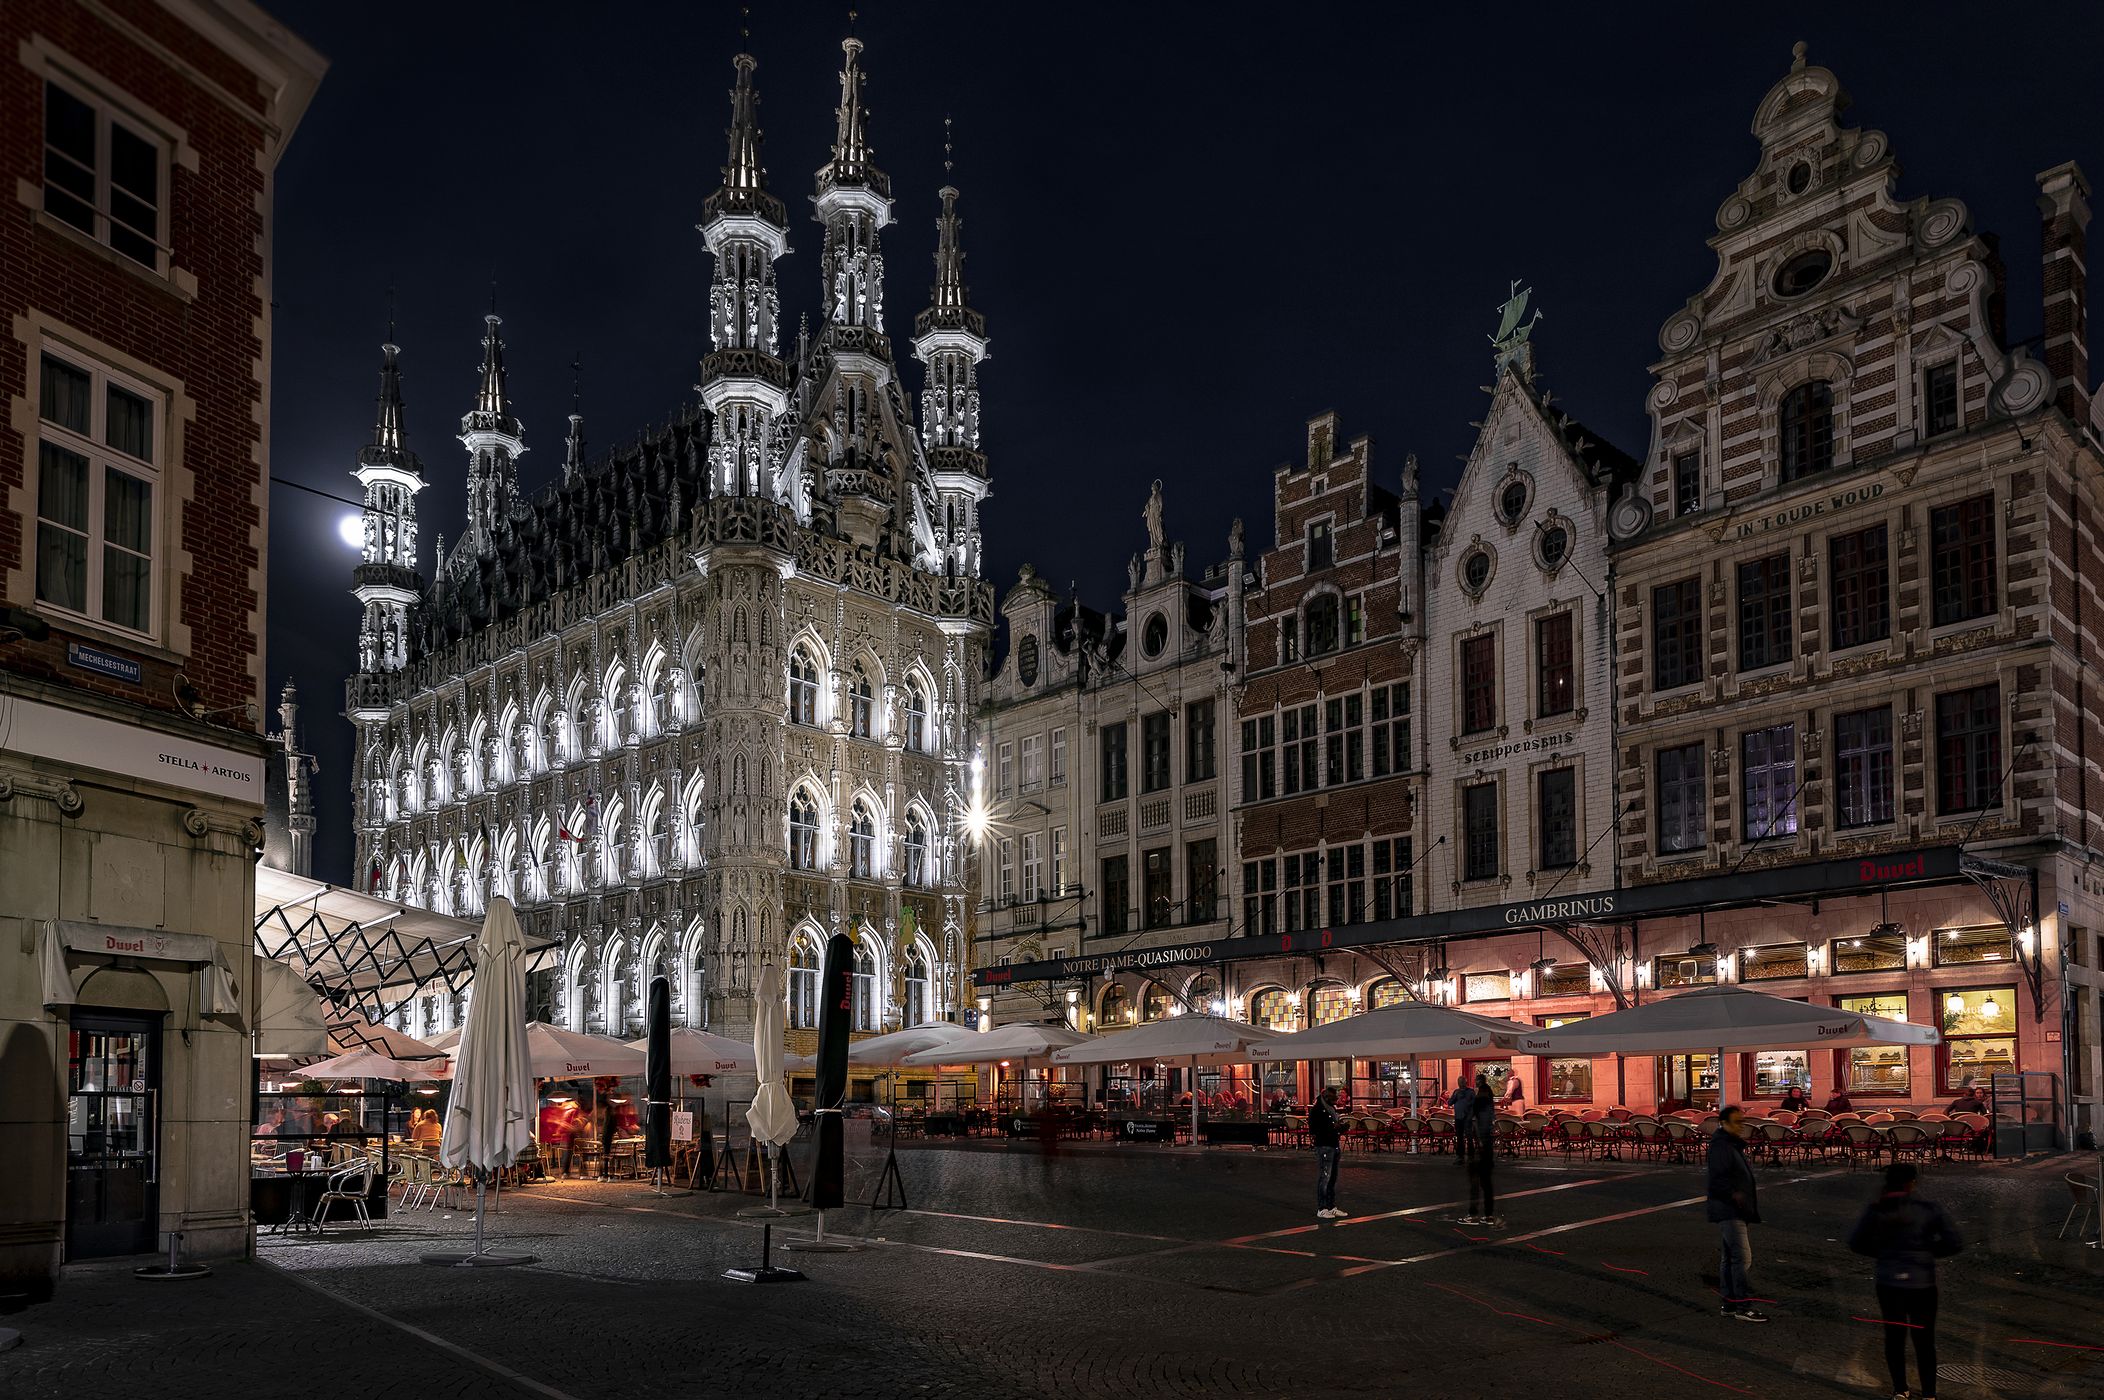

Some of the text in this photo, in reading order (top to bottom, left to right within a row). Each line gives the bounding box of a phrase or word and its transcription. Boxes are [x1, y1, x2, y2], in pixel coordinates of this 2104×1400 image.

[1737, 522, 1753, 538] IN
[1776, 501, 1825, 526] OUDE
[1831, 484, 1884, 509] WOUD
[78, 651, 138, 676] MECHELSESTRAAT
[158, 753, 251, 782] STELLA ARTOIS
[1859, 853, 1925, 881] Duvel
[1505, 896, 1614, 924] GAMBRINUS
[105, 935, 144, 952] Duvel
[1063, 945, 1212, 973] NOTRE DAME-QUASIMODO
[985, 966, 1012, 983] Duvel
[839, 970, 852, 1011] Duvel
[1818, 1024, 1848, 1035] Duvel
[1459, 1037, 1482, 1046] Duvel
[1527, 1040, 1551, 1049] Duvel
[1252, 1049, 1270, 1057] Duvel
[566, 1062, 590, 1072] Duvel
[714, 1061, 737, 1070] Duvel
